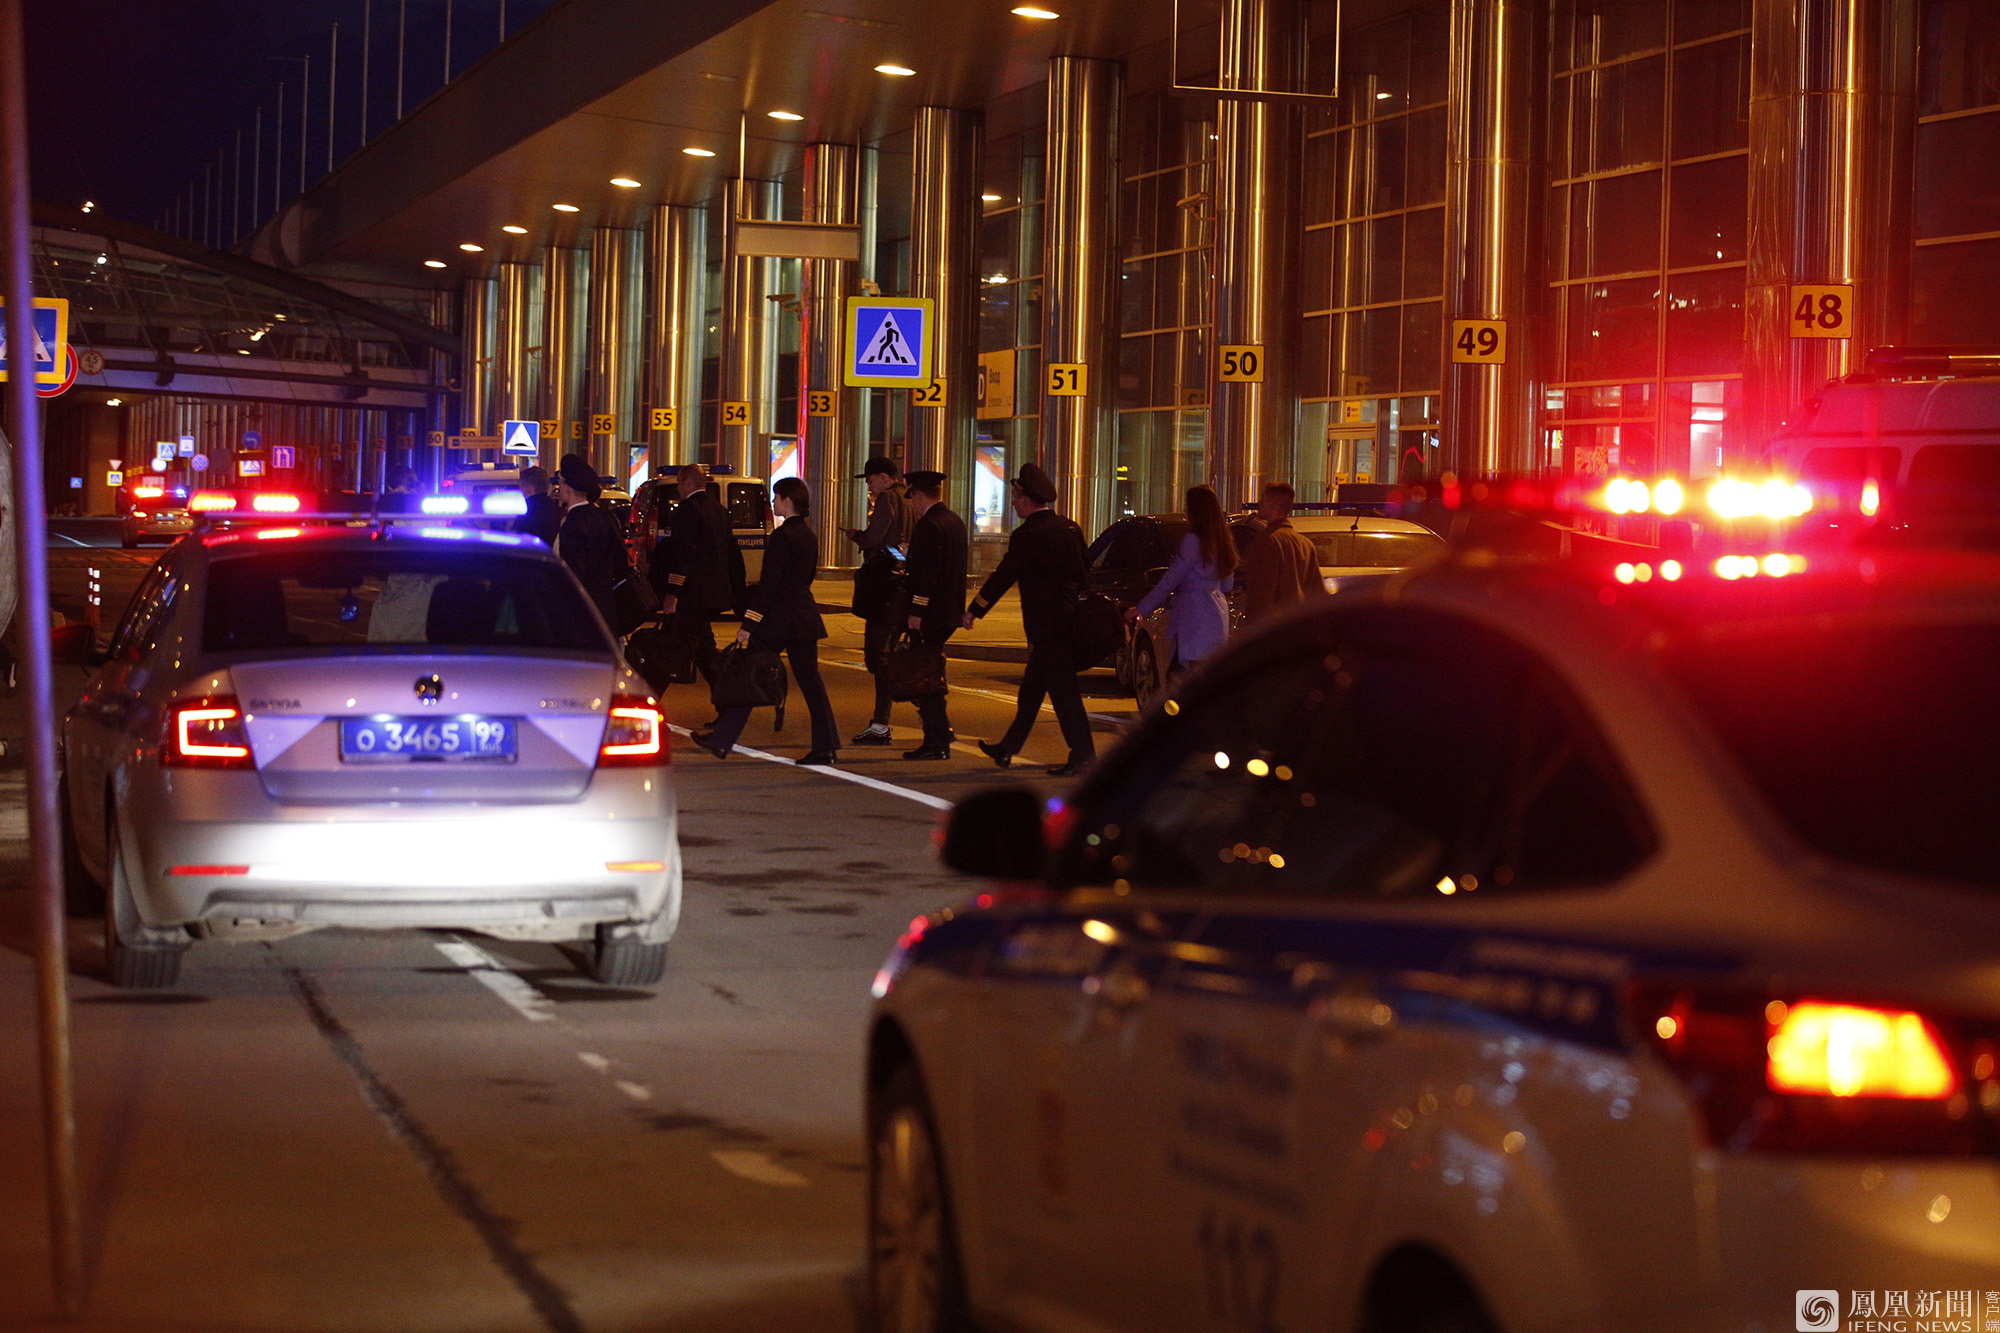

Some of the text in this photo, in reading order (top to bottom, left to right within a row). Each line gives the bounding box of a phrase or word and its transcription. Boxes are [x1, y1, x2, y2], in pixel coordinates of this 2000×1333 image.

[1794, 294, 1843, 329] 48
[1457, 327, 1499, 356] 49
[1223, 351, 1257, 376] 50
[1052, 369, 1079, 390] 51
[915, 383, 941, 402] 52
[810, 395, 830, 412] 53
[654, 412, 672, 426] 55
[725, 406, 746, 421] 54
[542, 423, 557, 435] 57
[575, 424, 584, 436] 5
[595, 418, 612, 431] 56
[738, 539, 764, 547] ЛИЦИЯ
[384, 722, 460, 751] 3465
[475, 721, 505, 751] 99
